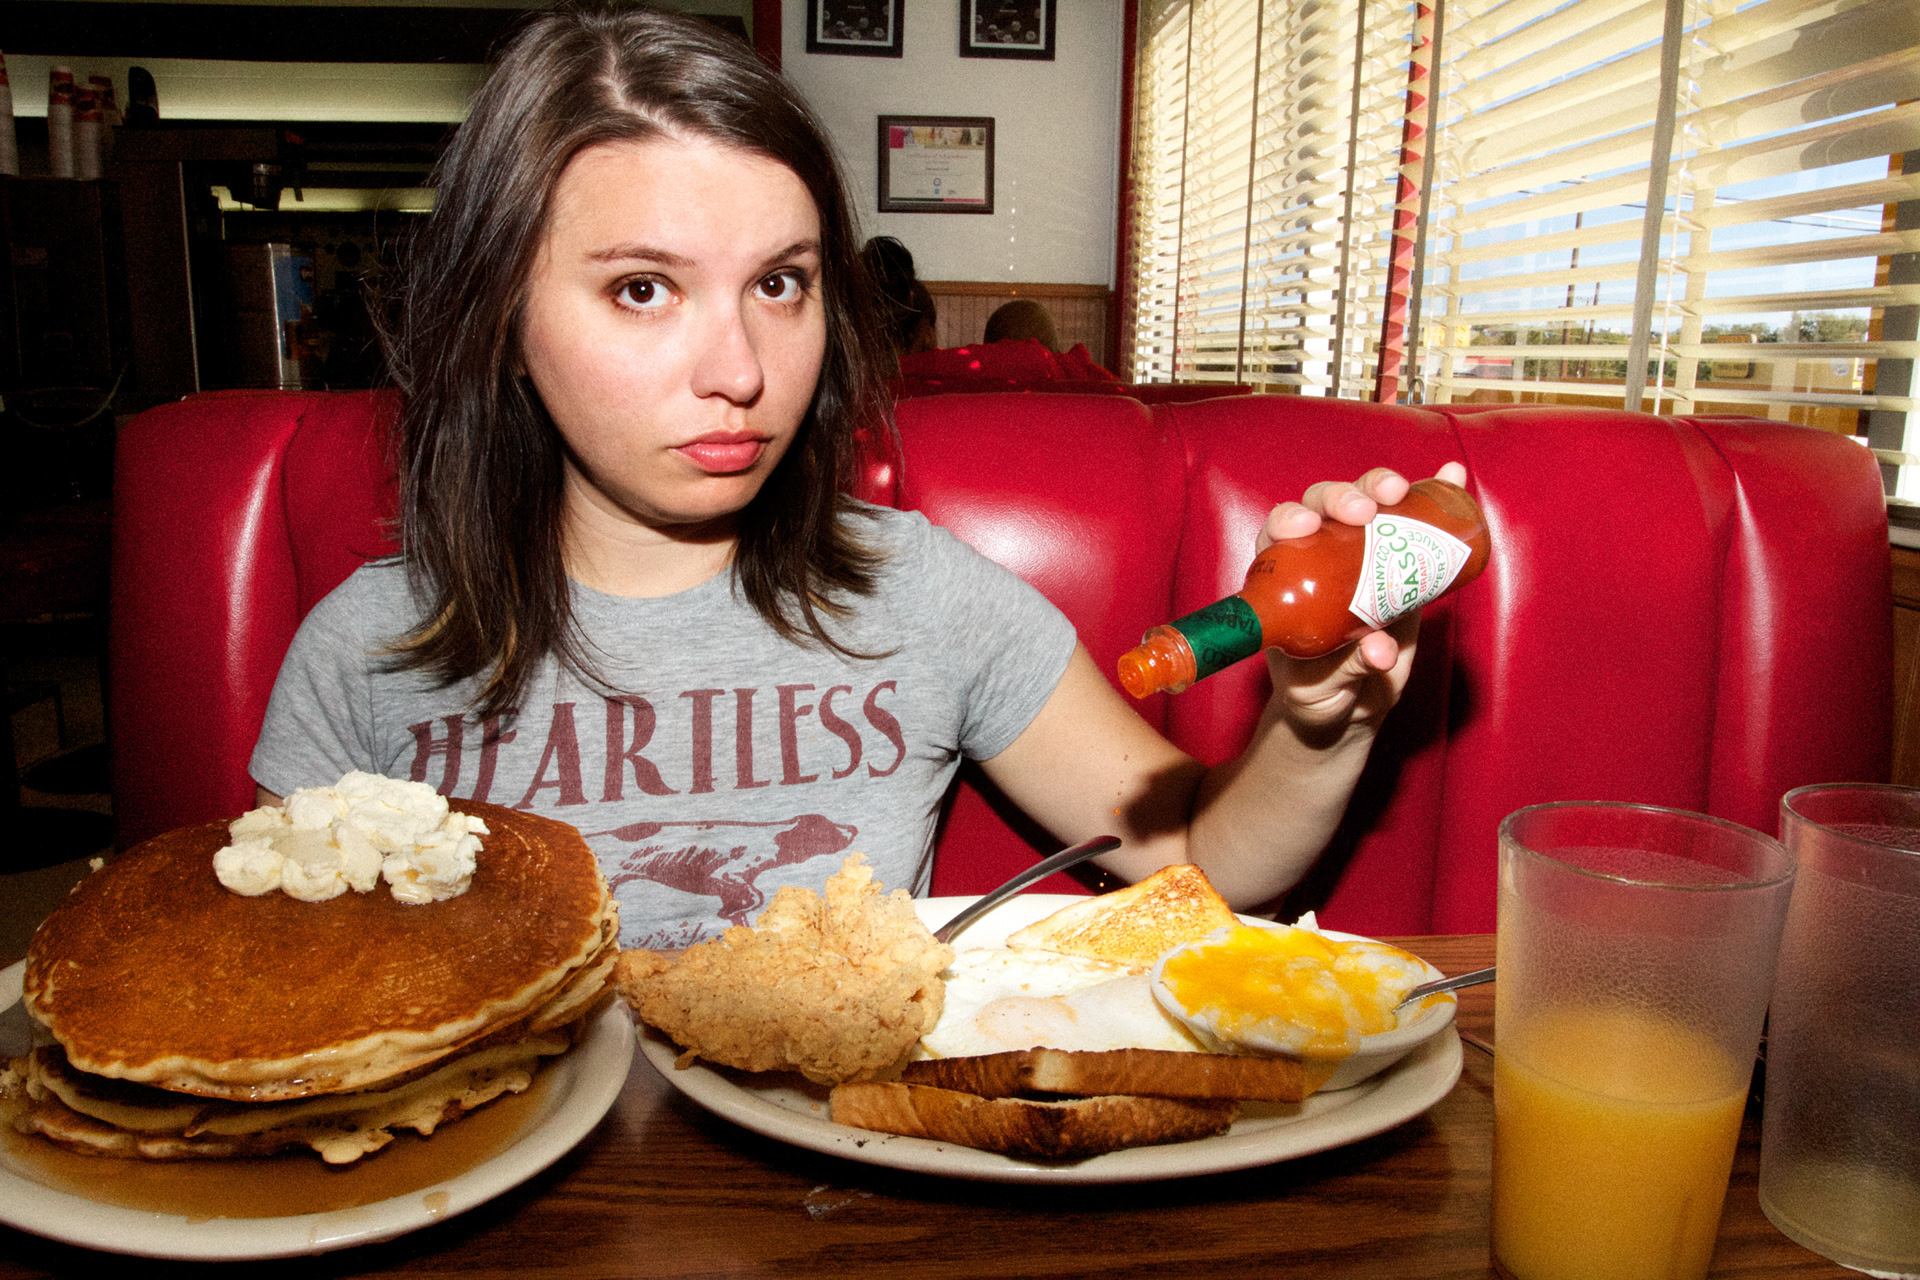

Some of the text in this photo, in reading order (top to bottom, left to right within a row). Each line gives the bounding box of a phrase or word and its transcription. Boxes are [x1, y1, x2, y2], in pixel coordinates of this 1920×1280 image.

[1377, 523, 1419, 615] ABASCO
[1406, 530, 1444, 560] SAUCE
[1417, 553, 1428, 593] BRAND
[407, 680, 906, 811] HEARTLESS
